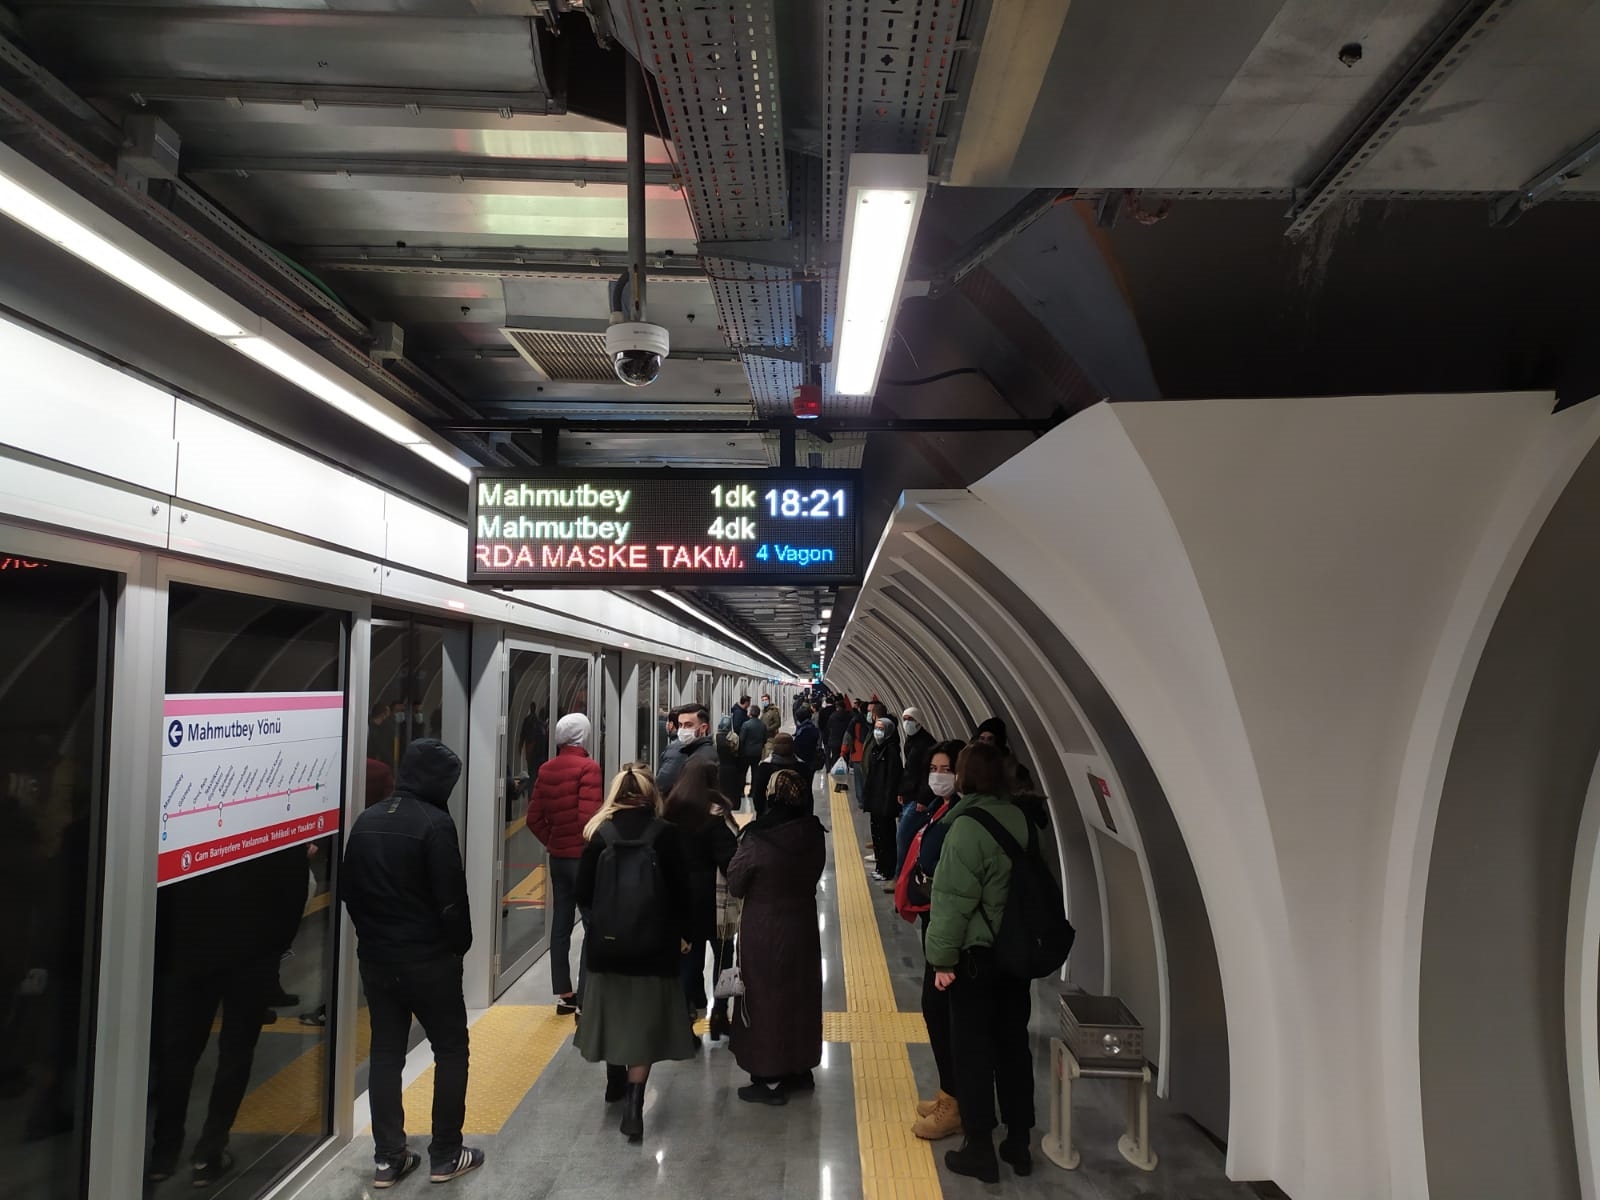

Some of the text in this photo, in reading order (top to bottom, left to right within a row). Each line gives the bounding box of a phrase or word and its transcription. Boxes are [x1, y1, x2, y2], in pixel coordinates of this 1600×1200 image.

[478, 484, 630, 512] Mahmutbey
[710, 486, 755, 508] 1dk
[765, 489, 845, 517] 18:21
[478, 516, 630, 544] Mahmutbey
[707, 517, 755, 540] 4dk
[542, 545, 648, 569] MASKE
[657, 545, 744, 569] TAKM
[756, 546, 833, 565] 4 Vagon
[188, 718, 281, 741] Mahmutbey Yönü
[194, 851, 208, 862] Cam
